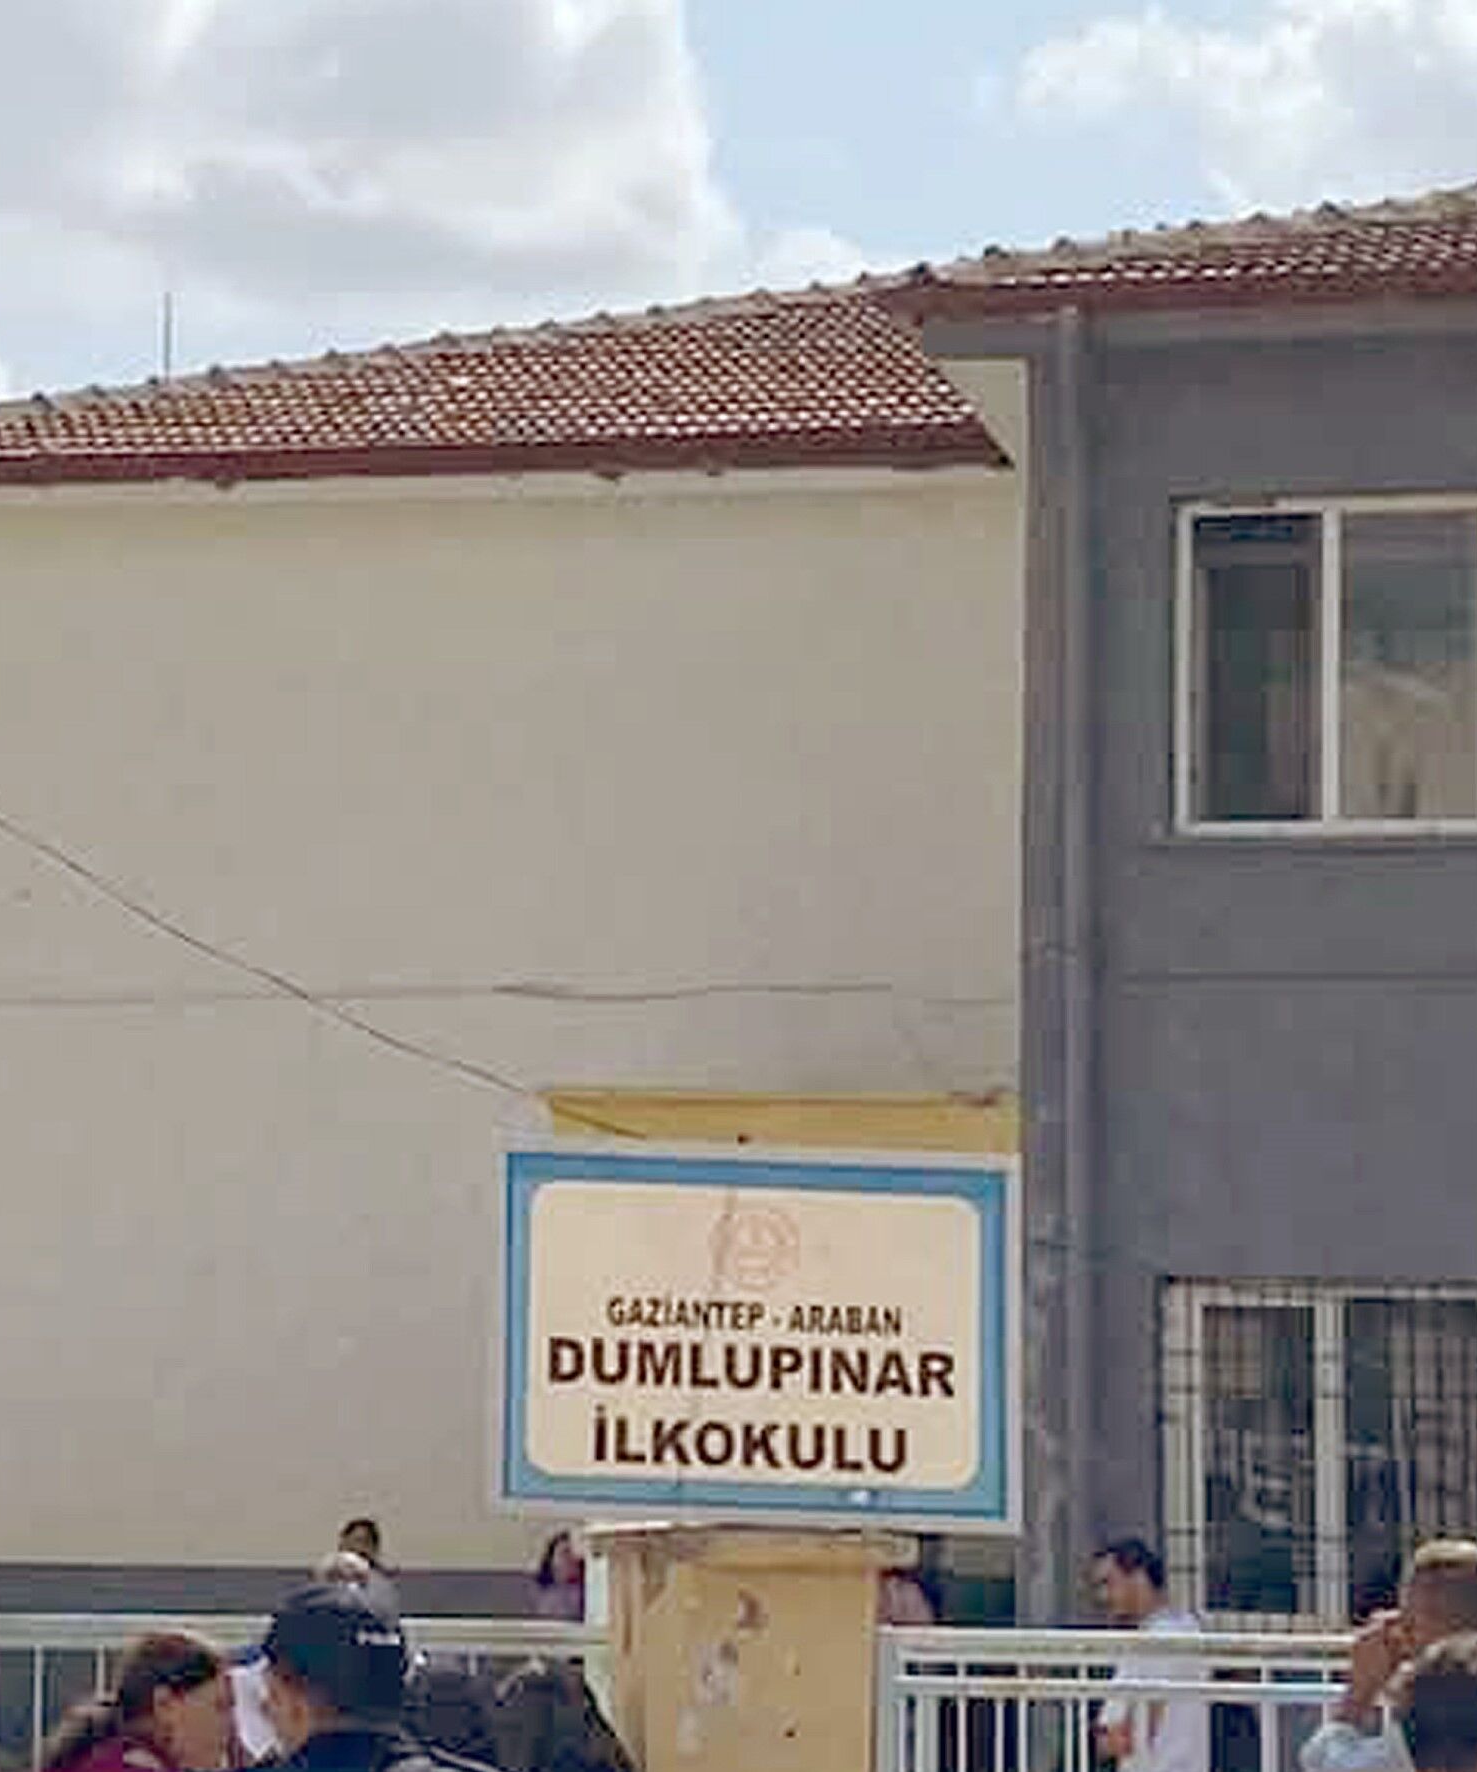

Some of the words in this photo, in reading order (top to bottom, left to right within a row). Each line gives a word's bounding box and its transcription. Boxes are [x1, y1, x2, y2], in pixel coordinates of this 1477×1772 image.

[788, 1305, 903, 1336] ARABAN
[549, 1337, 955, 1398] DUMLUPINAR
[593, 1405, 908, 1473] İLKOKULU
